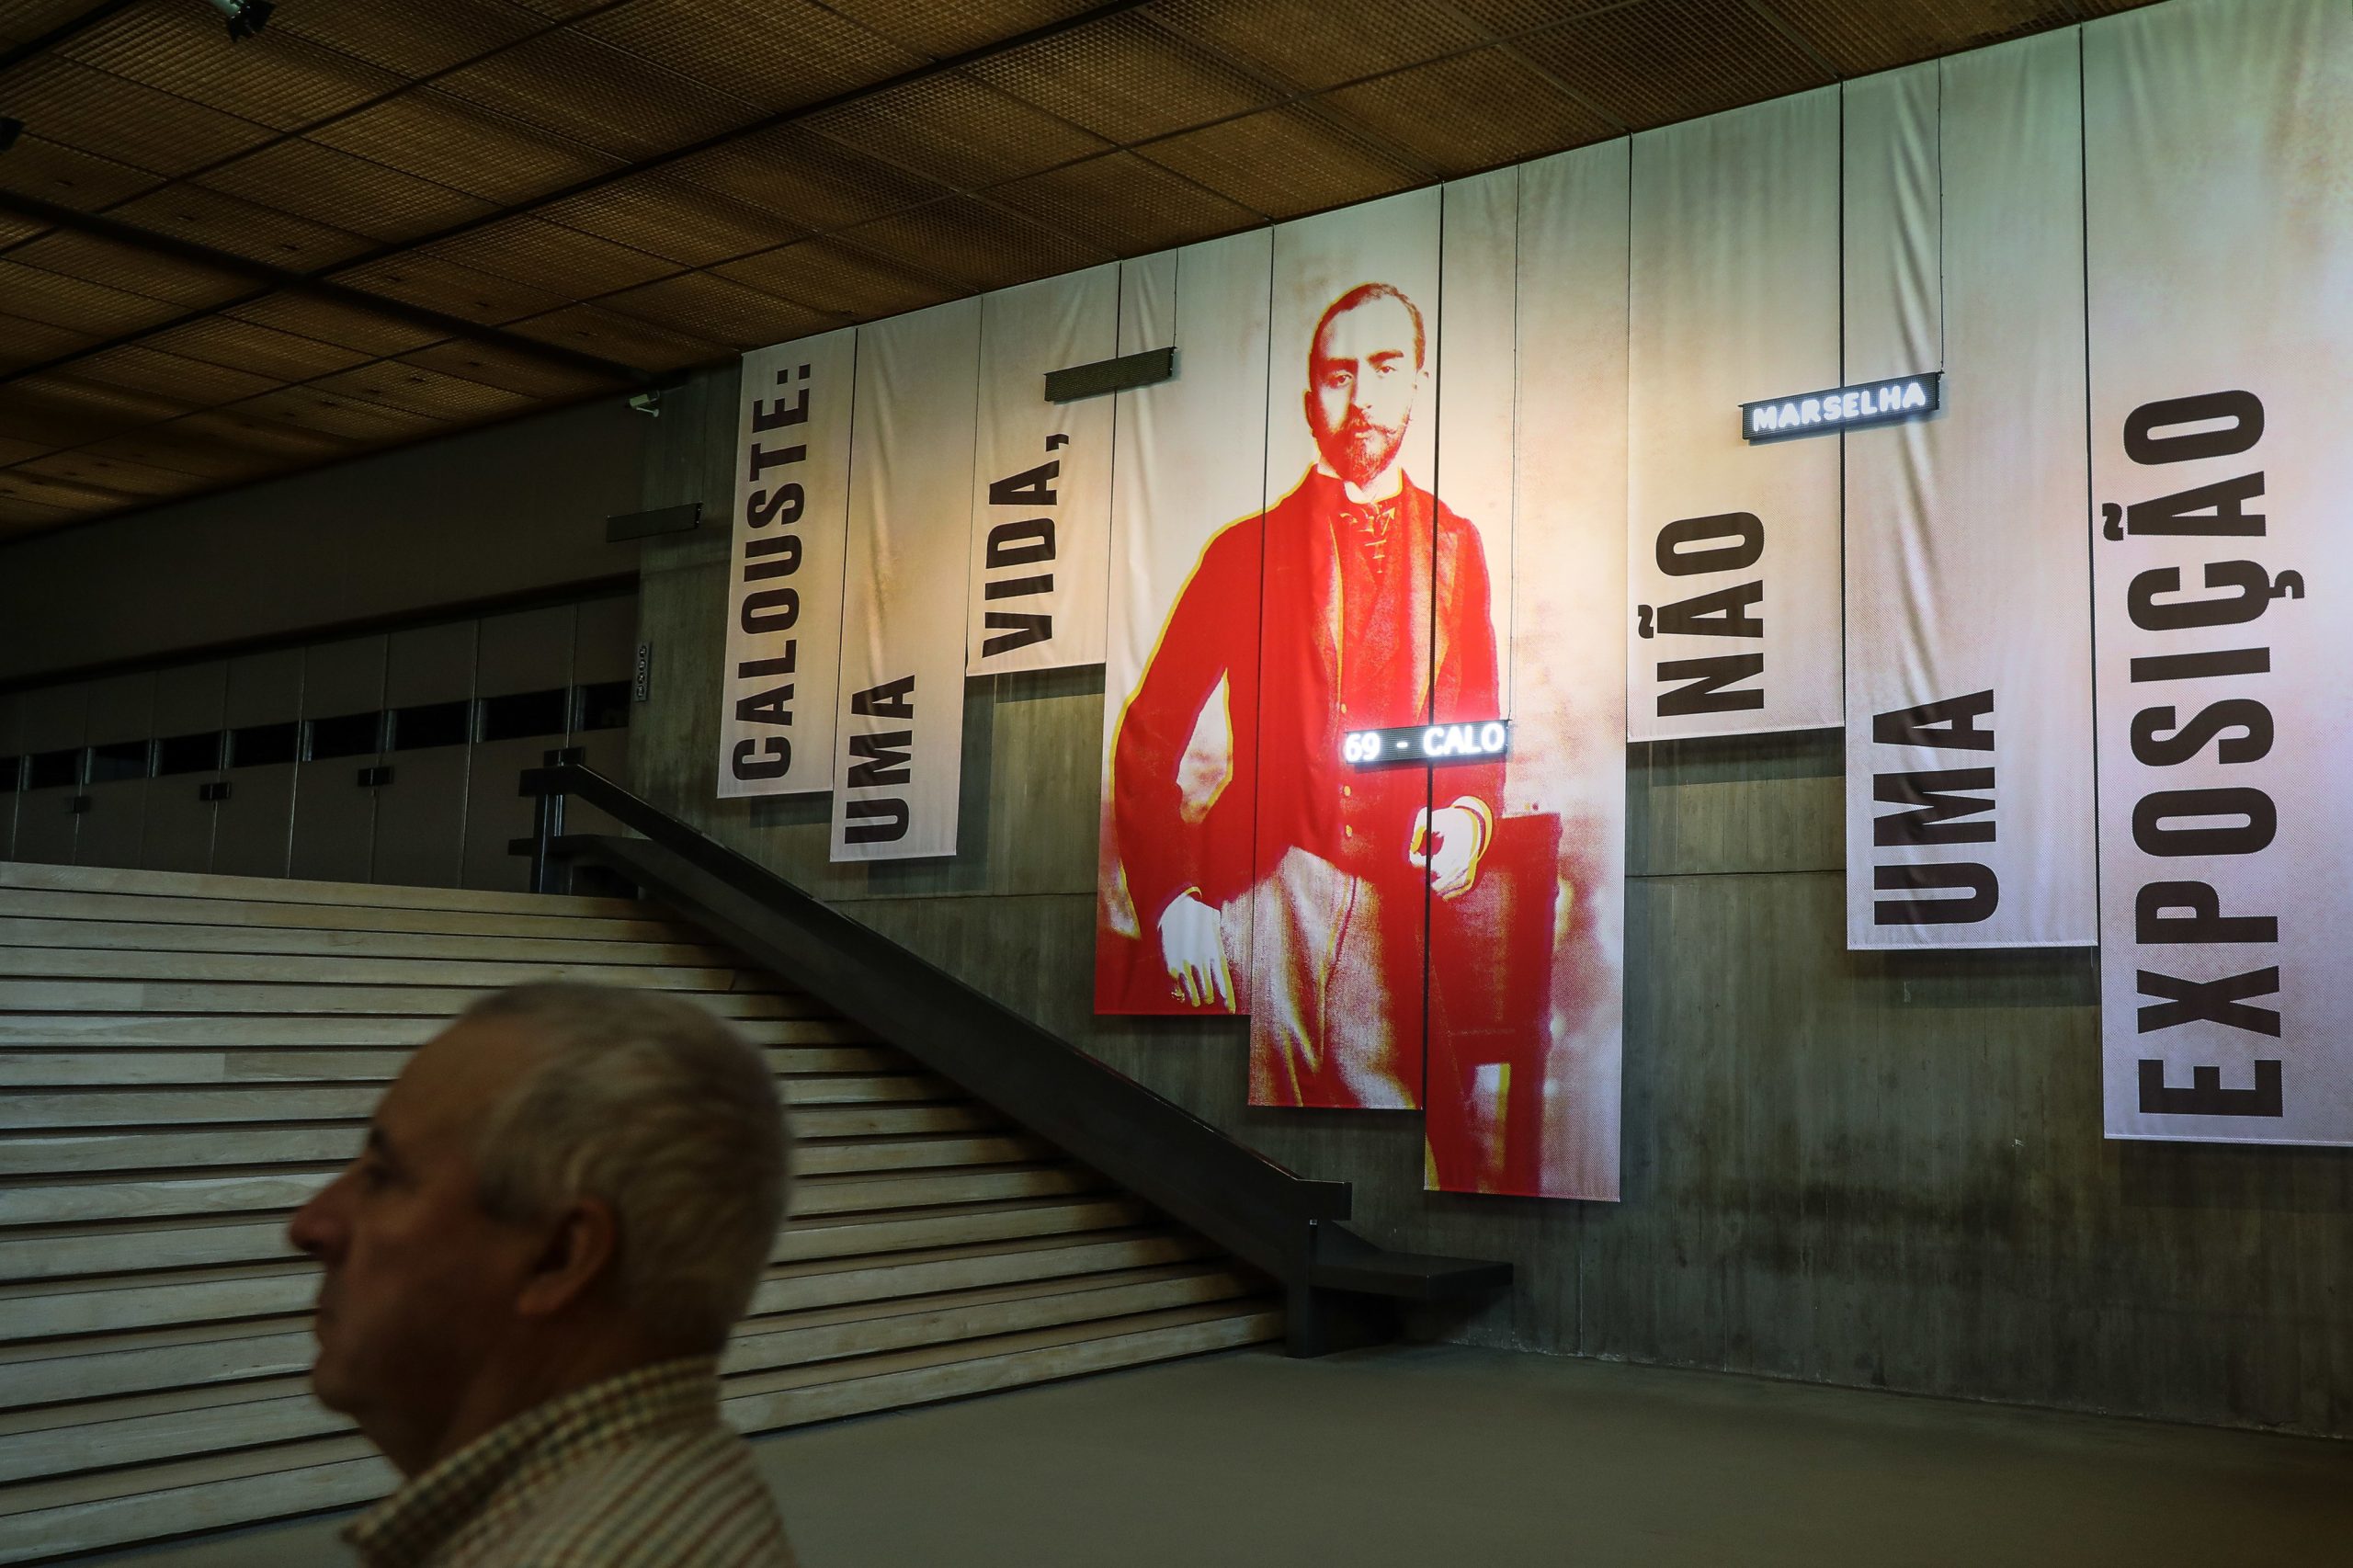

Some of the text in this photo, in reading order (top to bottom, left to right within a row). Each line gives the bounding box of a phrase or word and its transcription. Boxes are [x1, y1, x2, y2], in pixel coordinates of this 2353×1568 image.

[1753, 382, 1927, 432] MARSELHA
[732, 362, 813, 782] CALOUSTE:
[982, 433, 1070, 659] VIDA,
[1637, 511, 1765, 718] NÃO
[844, 675, 915, 845] UMA
[1345, 732, 1381, 762] 69
[1424, 722, 1506, 756] CALO
[1872, 688, 1999, 926] UMA
[2102, 390, 2305, 1119] EXPOSIÇÃO
